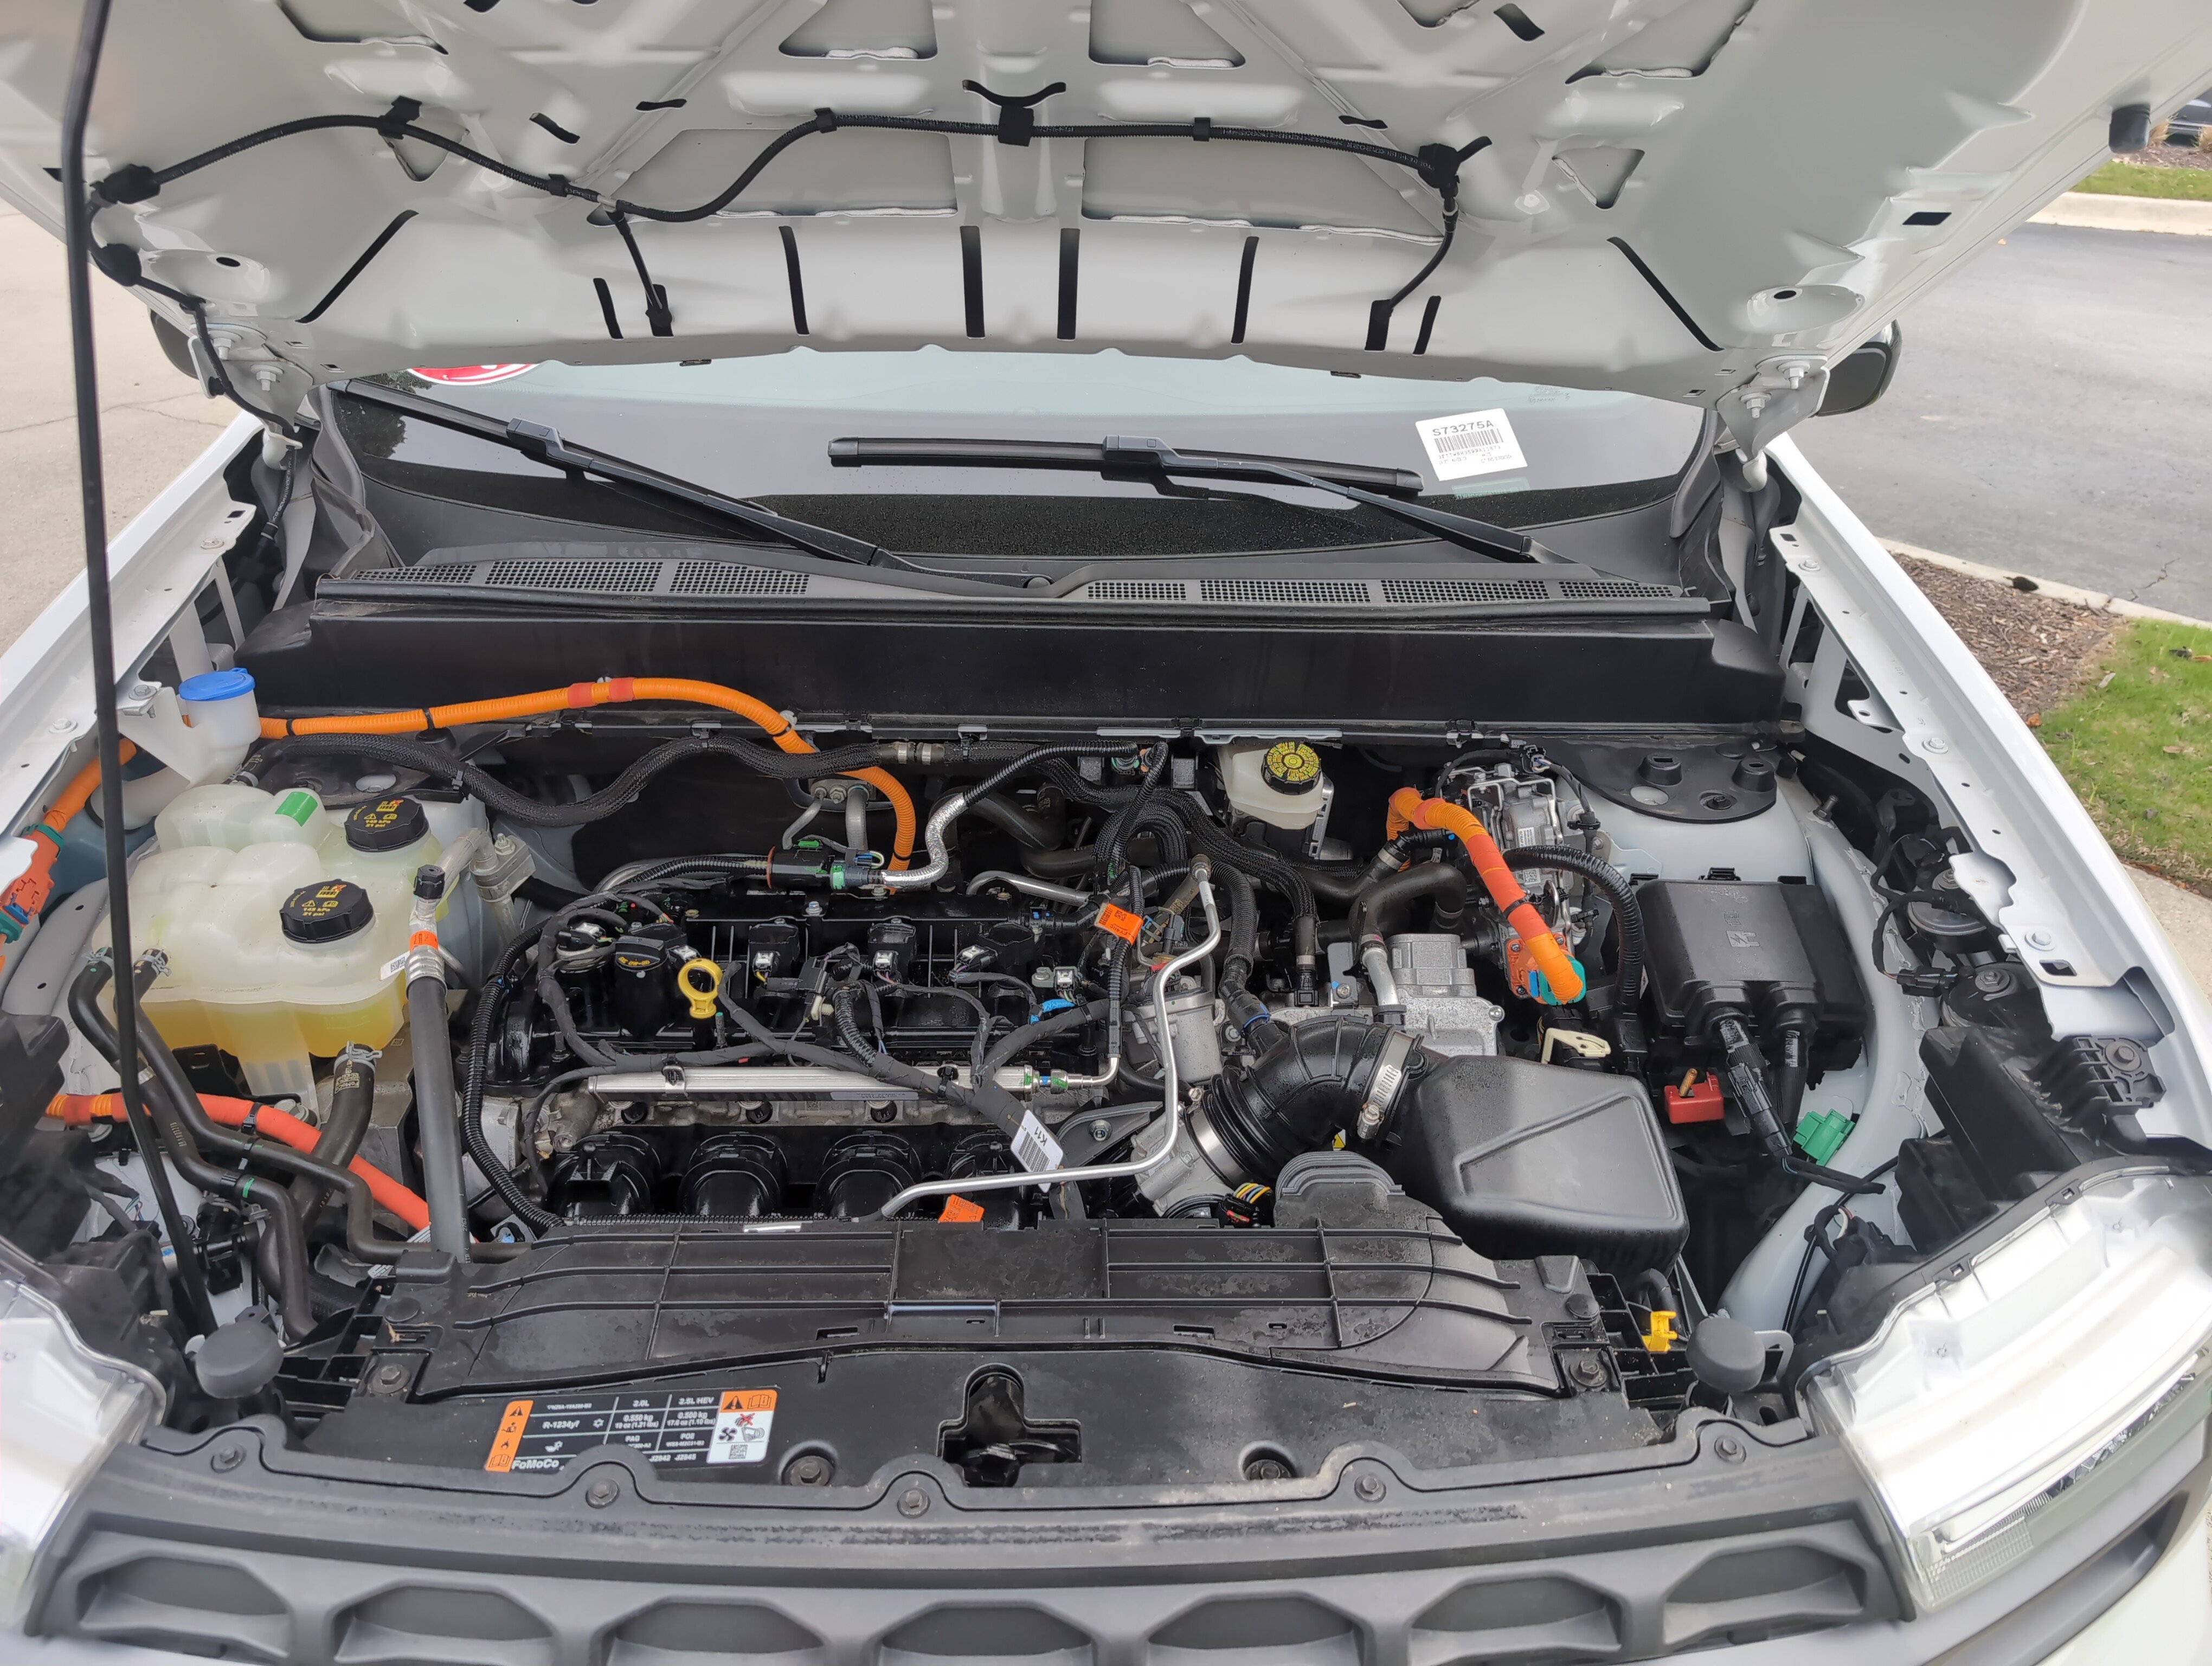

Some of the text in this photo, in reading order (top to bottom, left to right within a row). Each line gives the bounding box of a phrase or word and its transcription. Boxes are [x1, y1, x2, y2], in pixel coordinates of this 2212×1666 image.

[1432, 420, 1494, 436] S73275A
[1034, 1126, 1048, 1146] K11
[643, 1414, 654, 1422] kg
[698, 1411, 708, 1420] kg
[542, 1420, 581, 1430] R-1234yf
[511, 1458, 560, 1470] FoMoCo
